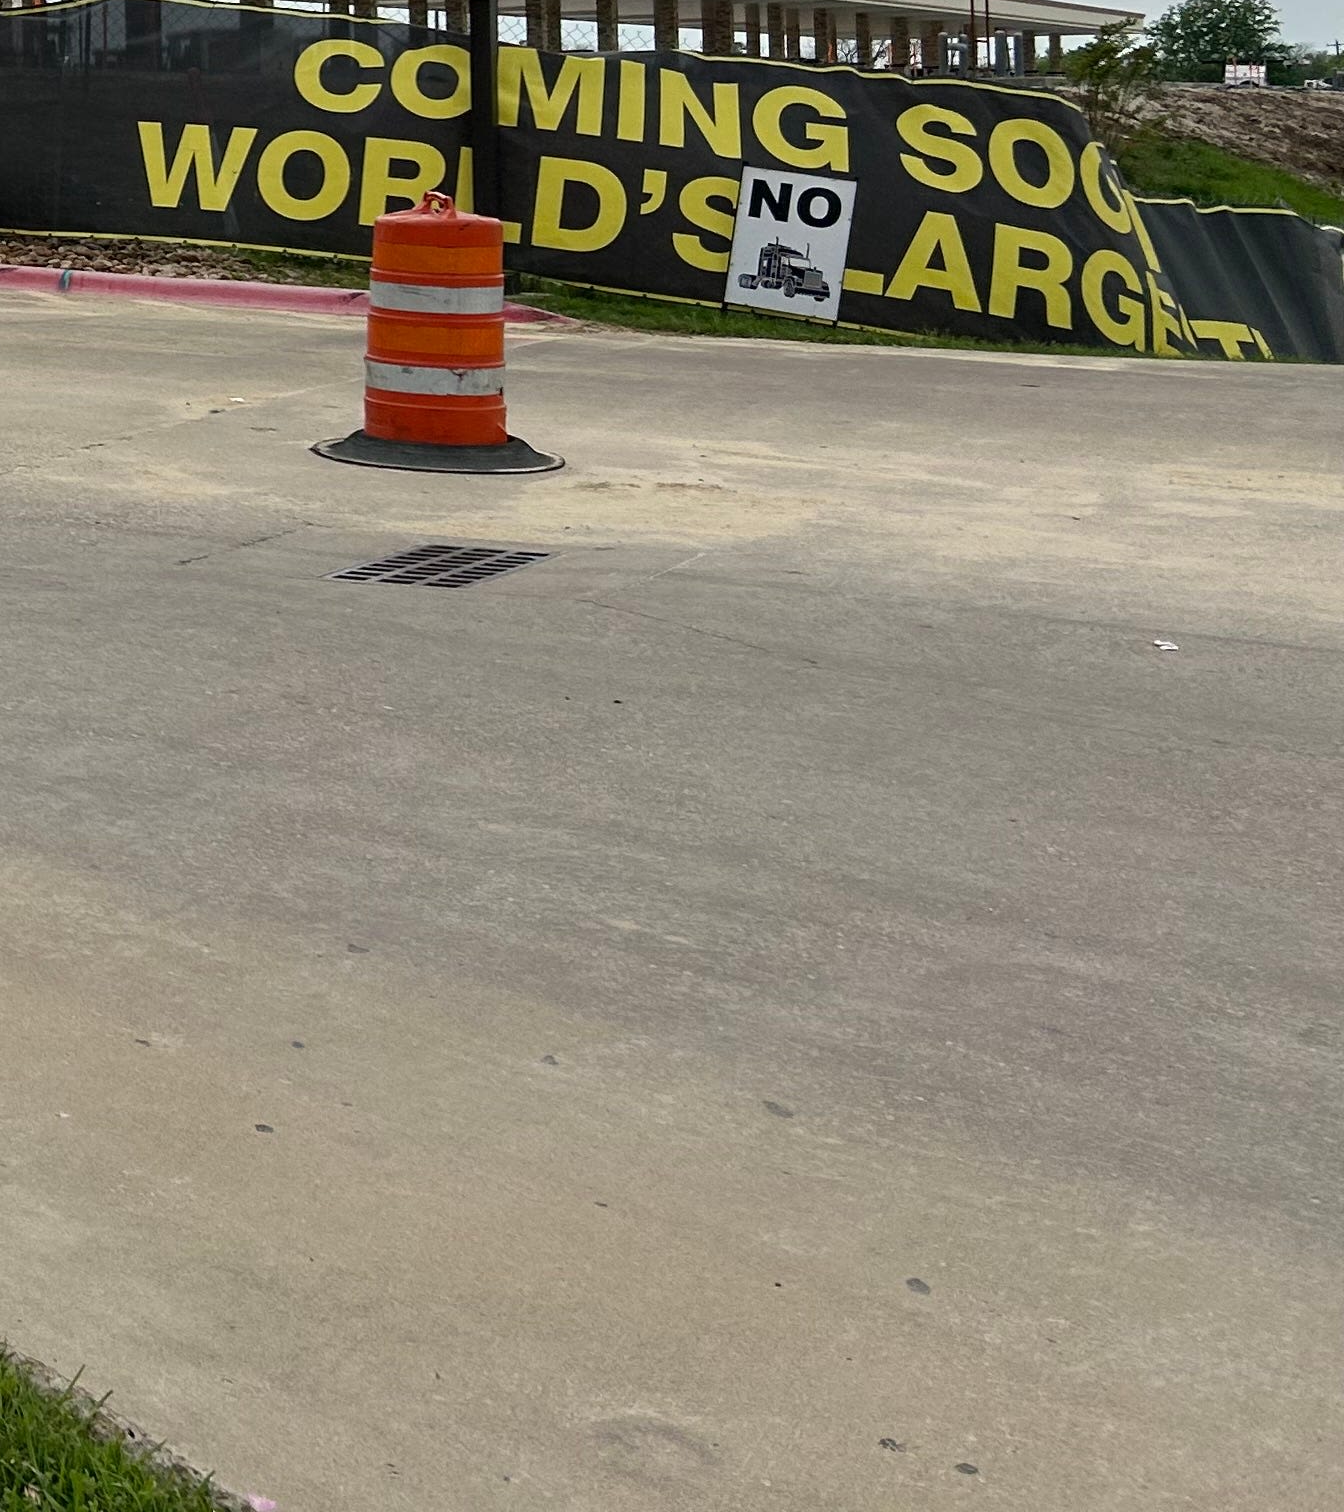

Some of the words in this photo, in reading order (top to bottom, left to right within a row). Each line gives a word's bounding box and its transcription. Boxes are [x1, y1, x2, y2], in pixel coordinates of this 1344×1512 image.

[294, 39, 850, 172] COMING
[896, 104, 1160, 272] SOO
[748, 179, 843, 229] NO
